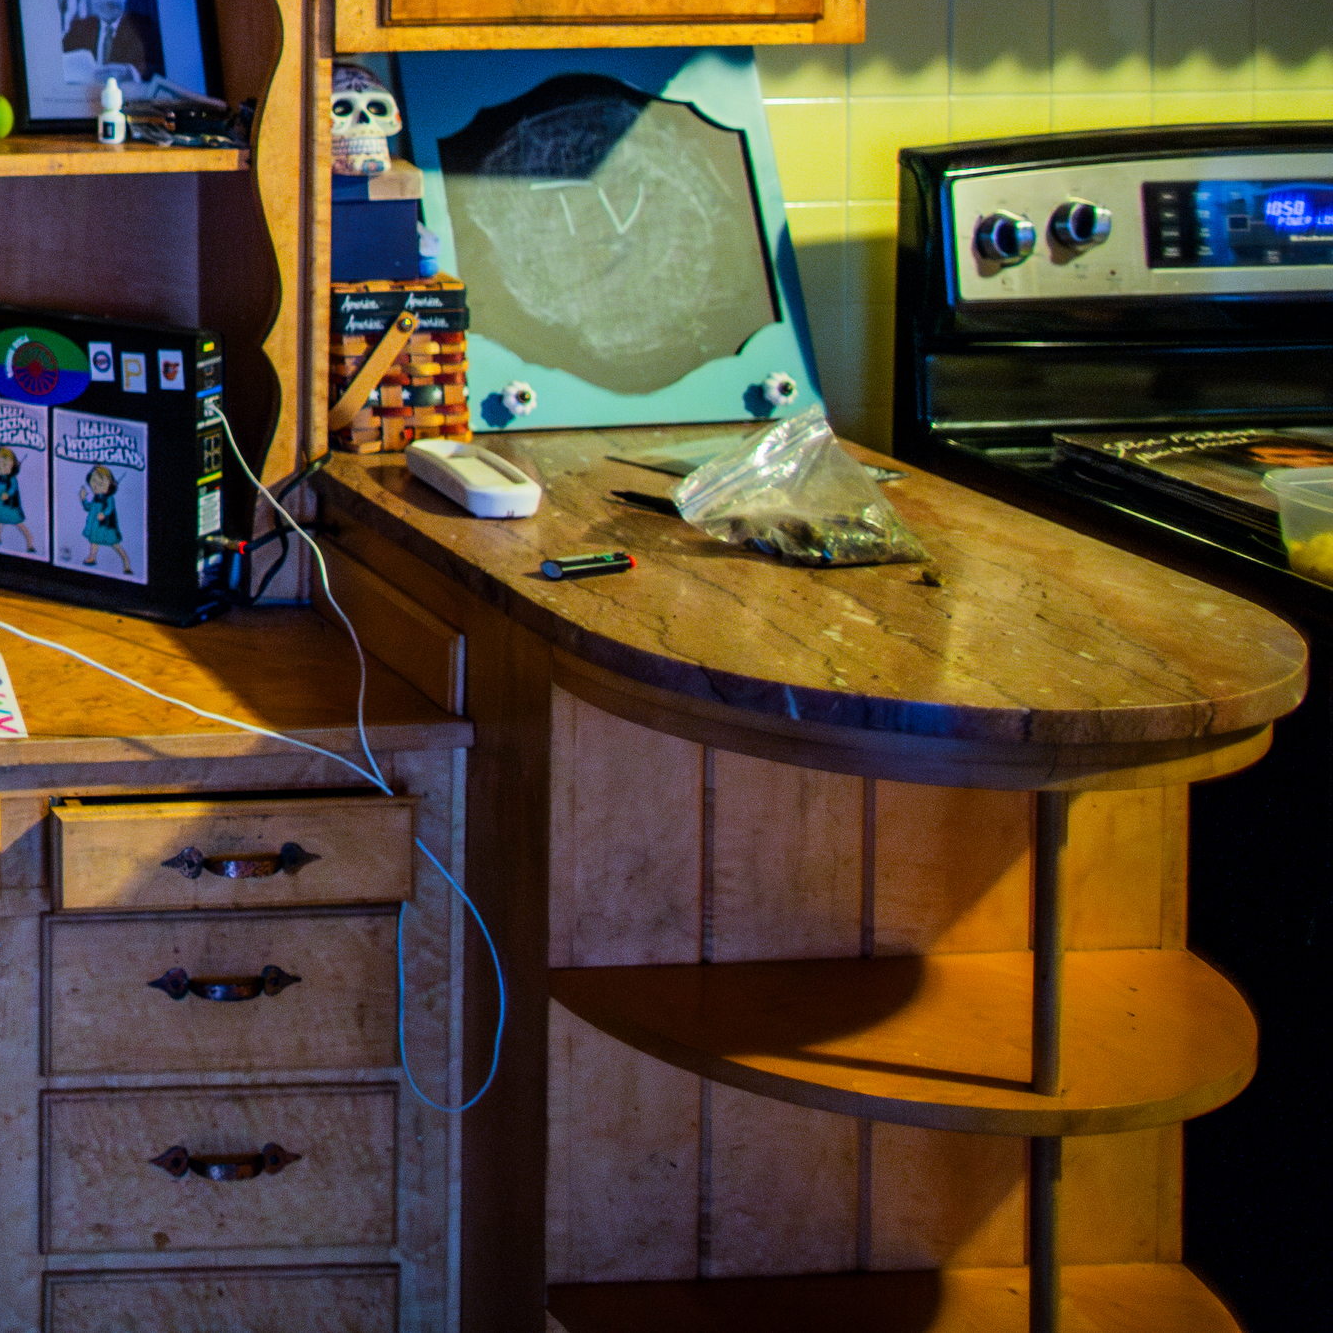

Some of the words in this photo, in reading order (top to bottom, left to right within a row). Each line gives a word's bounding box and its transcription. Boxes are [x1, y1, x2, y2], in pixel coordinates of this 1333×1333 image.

[1277, 215, 1313, 227] POWER
[63, 434, 137, 452] WORKING
[55, 442, 145, 471] AMERICANS
